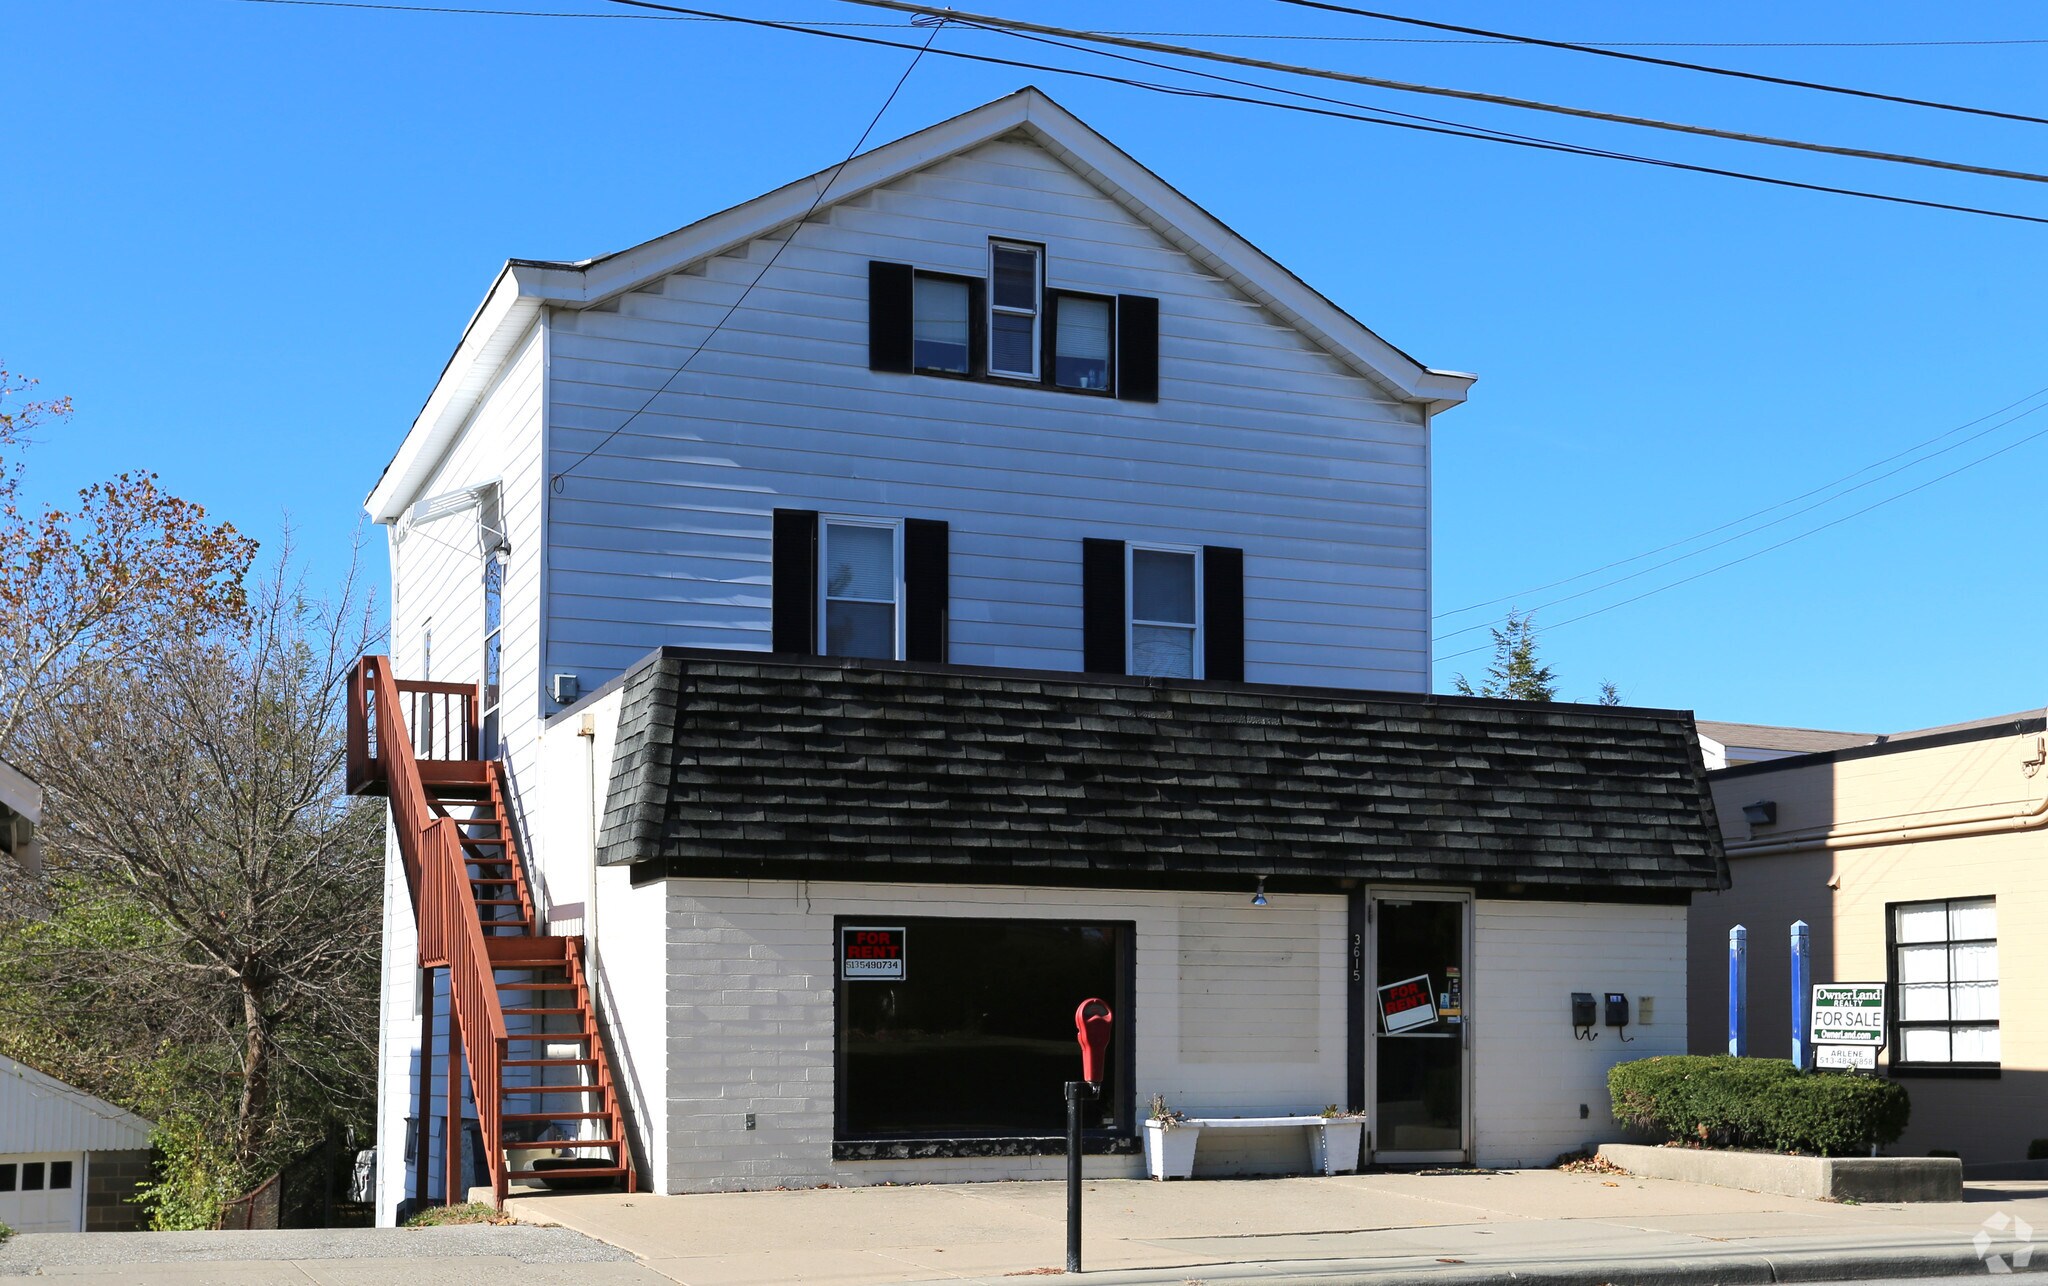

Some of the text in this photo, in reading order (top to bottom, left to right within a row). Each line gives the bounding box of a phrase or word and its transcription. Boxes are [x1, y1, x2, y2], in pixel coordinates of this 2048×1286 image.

[857, 932, 890, 945] FOR
[848, 945, 899, 958] RENT
[846, 961, 898, 969] 5135490734
[1389, 982, 1418, 1000] FOR
[1817, 989, 1880, 1000] OwnerLand
[1384, 992, 1428, 1015] RENT
[1815, 1011, 1881, 1027] FOR SALE
[1821, 1029, 1871, 1040] OwnerLand.com
[1831, 1050, 1863, 1058] ARLENE
